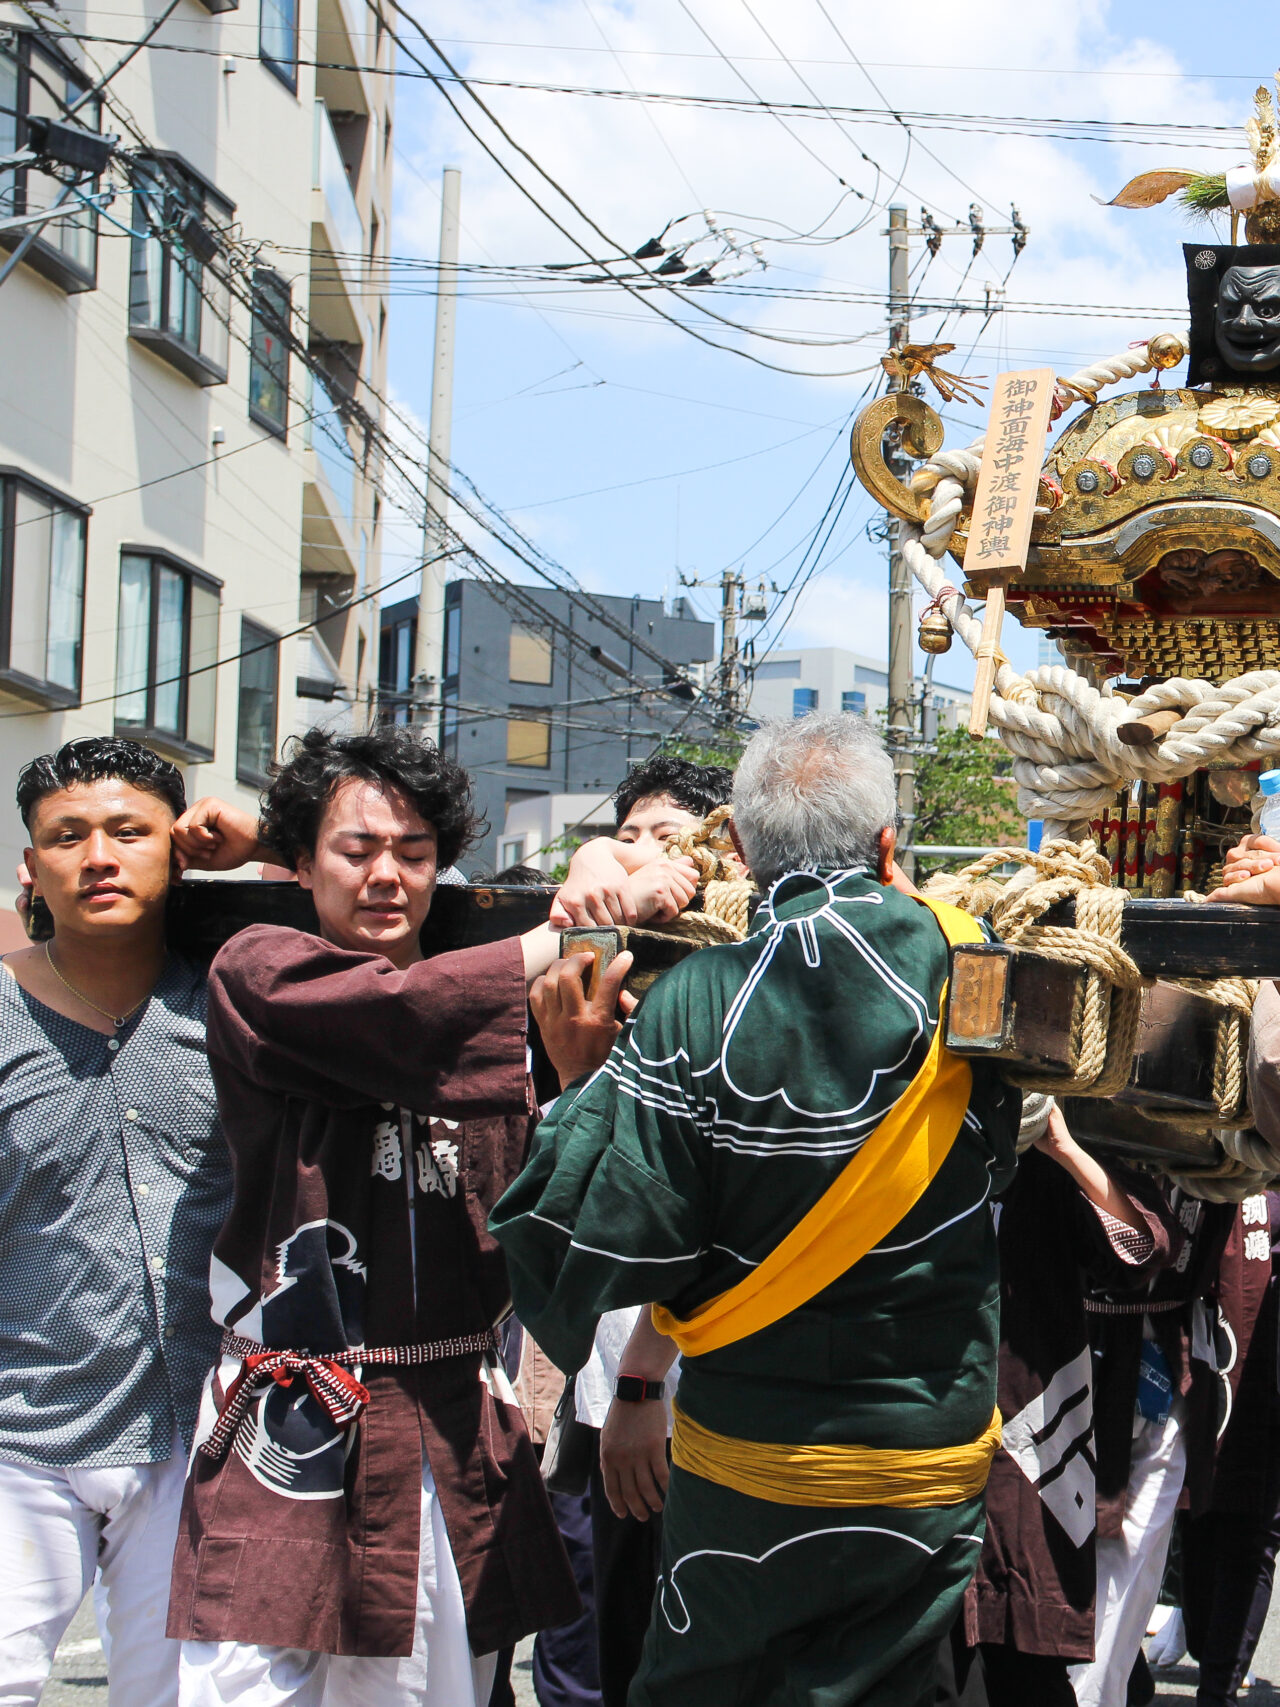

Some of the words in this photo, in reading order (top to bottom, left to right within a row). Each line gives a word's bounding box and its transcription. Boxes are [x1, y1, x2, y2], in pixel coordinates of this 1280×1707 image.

[975, 379, 1038, 559] 御神面海中渡御神輿
